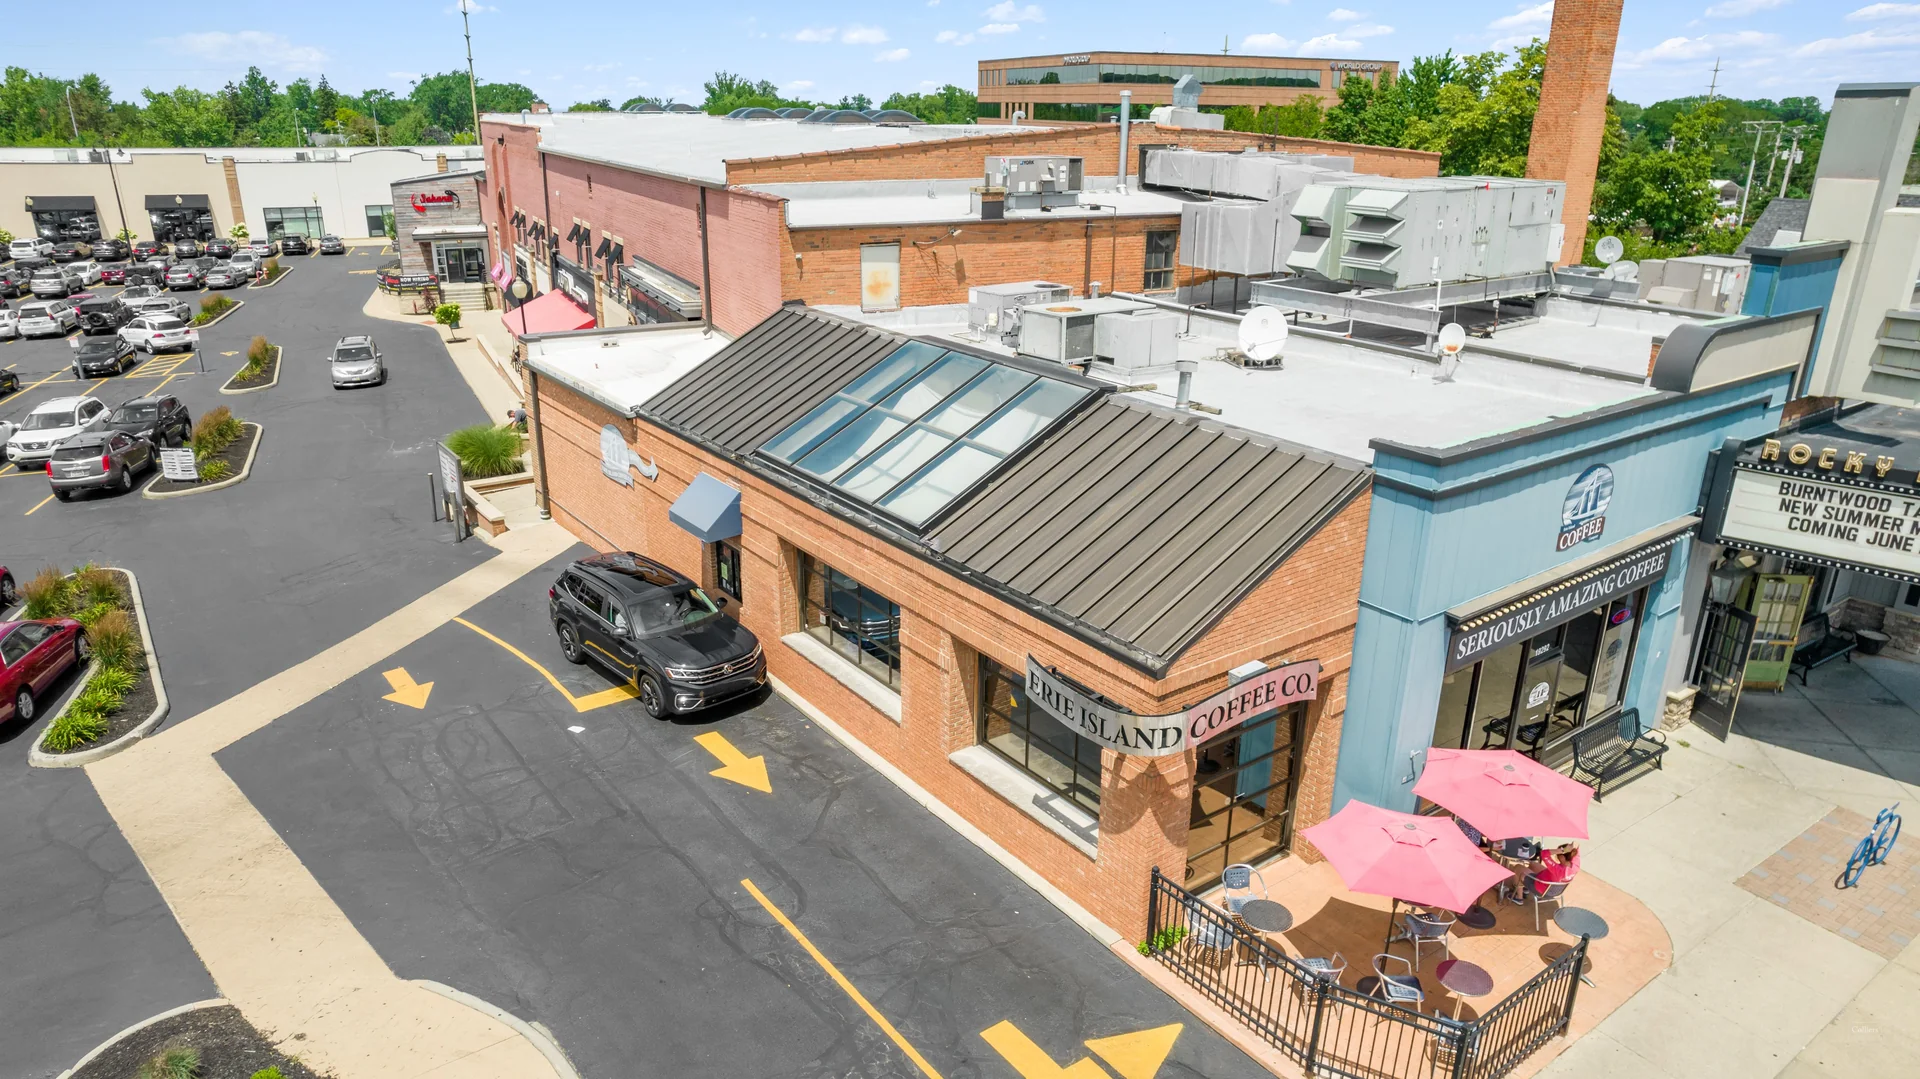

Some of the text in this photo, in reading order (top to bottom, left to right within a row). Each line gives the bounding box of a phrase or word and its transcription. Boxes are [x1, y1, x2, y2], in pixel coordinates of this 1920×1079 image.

[1761, 438, 1895, 477] ROCKY
[1778, 481, 1892, 513] BURNTWOOD
[1778, 498, 1818, 517] NEW
[1823, 506, 1905, 533] SUMMER
[1559, 517, 1603, 550] COFFEE
[1788, 516, 1915, 552] COMING JUNE
[1456, 552, 1666, 660] SERIOUSLY AMAZING COFFEE
[1028, 668, 1183, 750] ERIE ISLAND
[1190, 672, 1316, 739] COFFEE CO.
